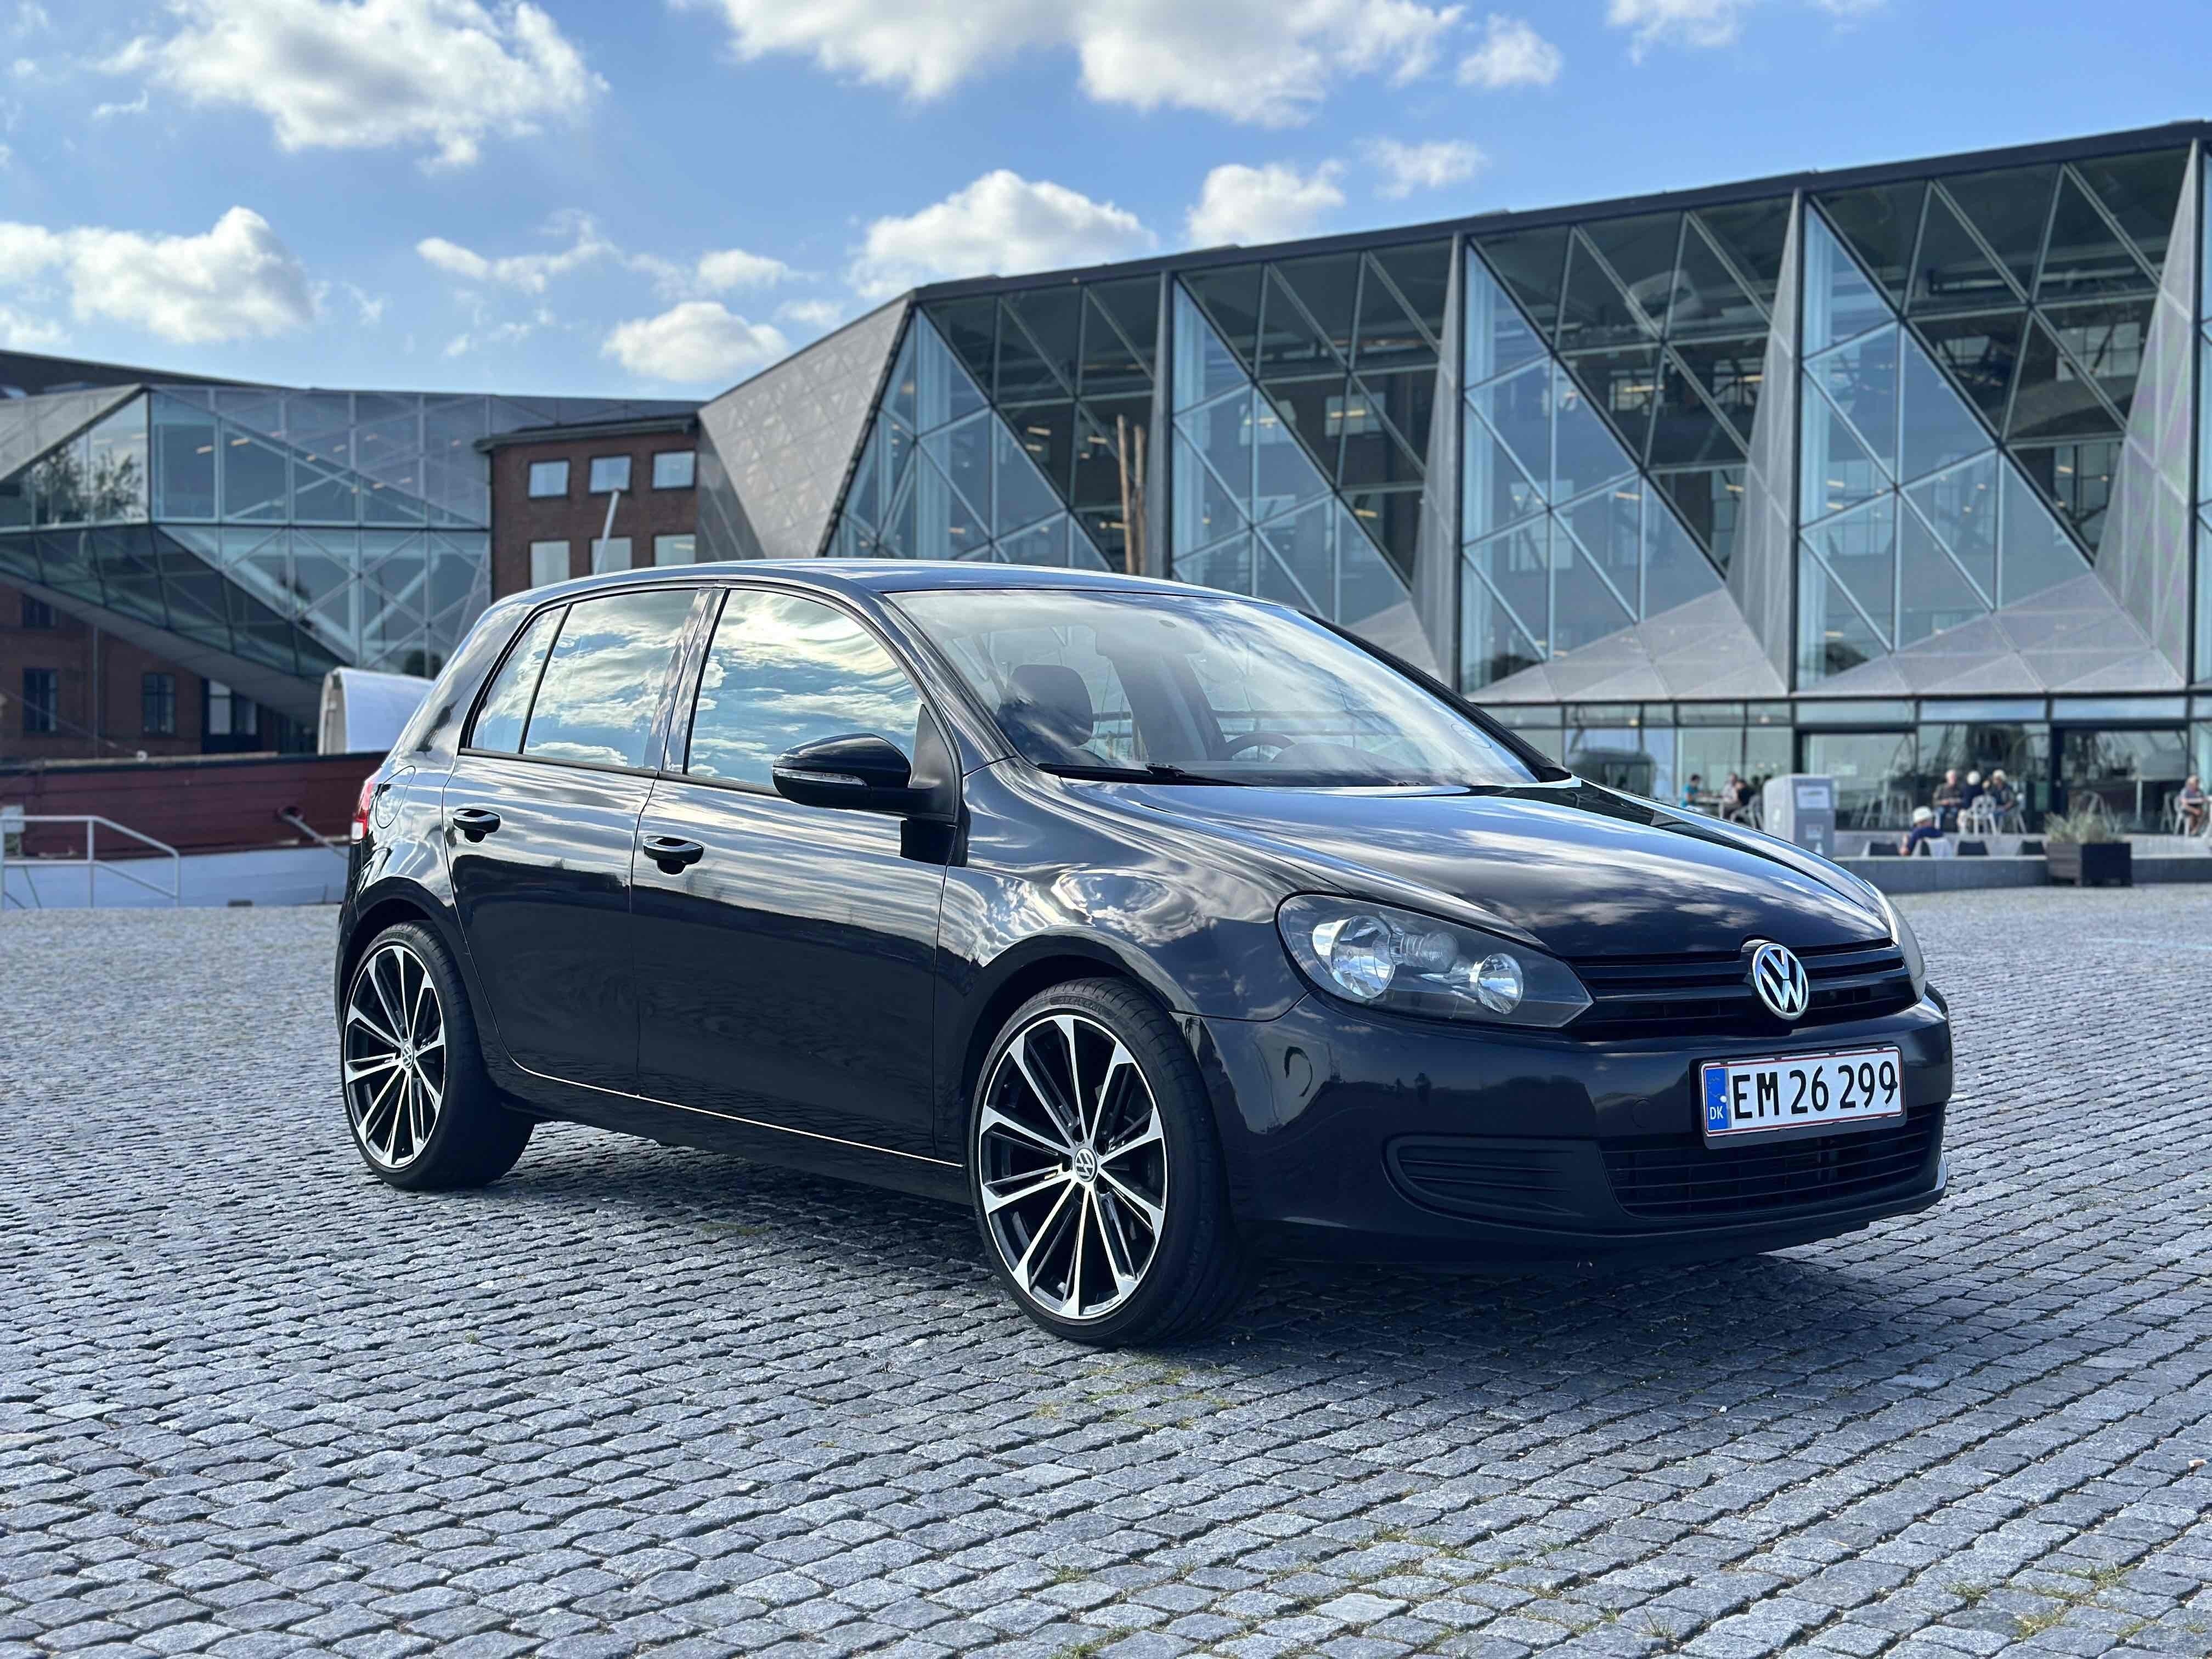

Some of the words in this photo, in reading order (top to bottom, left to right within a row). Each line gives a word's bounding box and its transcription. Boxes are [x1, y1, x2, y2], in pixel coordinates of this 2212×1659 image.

[1753, 943, 1809, 1020] VW
[1709, 1105, 1724, 1120] DK
[1732, 1071, 1780, 1120] EM
[1789, 1065, 1829, 1115] 26
[1838, 1060, 1897, 1109] 299
